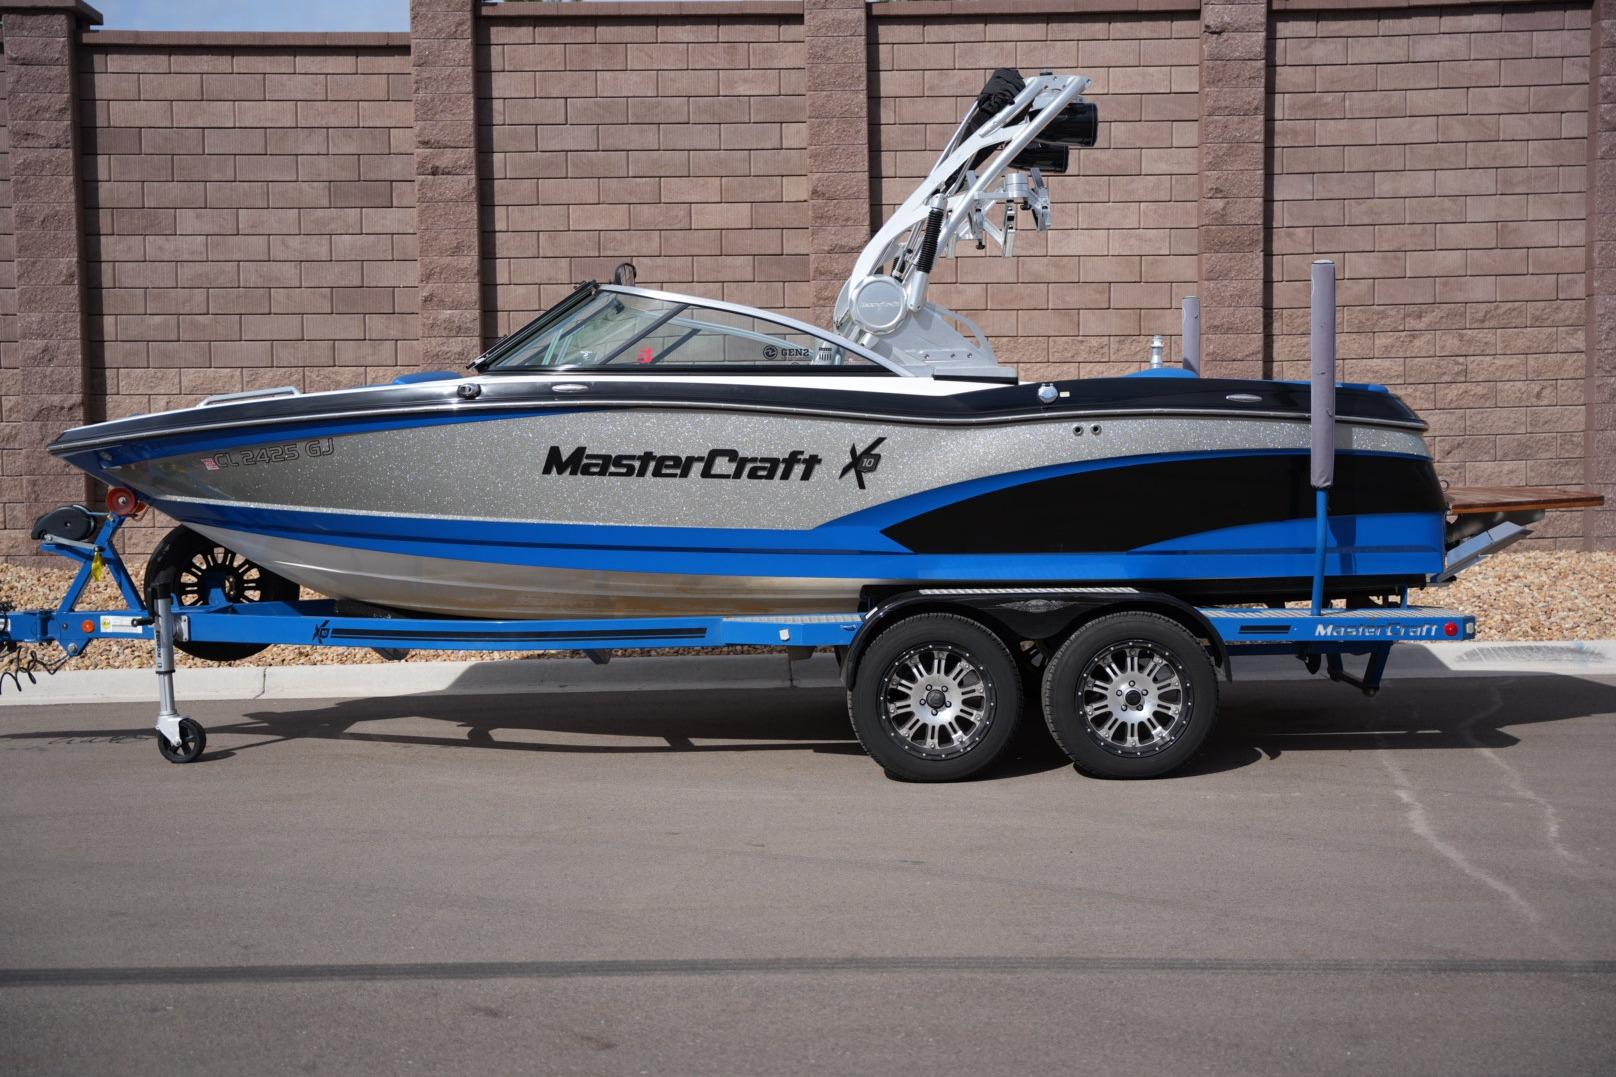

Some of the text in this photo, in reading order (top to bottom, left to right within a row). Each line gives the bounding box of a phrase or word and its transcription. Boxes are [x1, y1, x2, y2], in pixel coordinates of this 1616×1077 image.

[213, 453, 239, 467] CL
[240, 444, 300, 466] 2425
[304, 437, 335, 458] GJ
[542, 445, 823, 481] MasterCraft
[1315, 623, 1438, 637] MasterCraft
